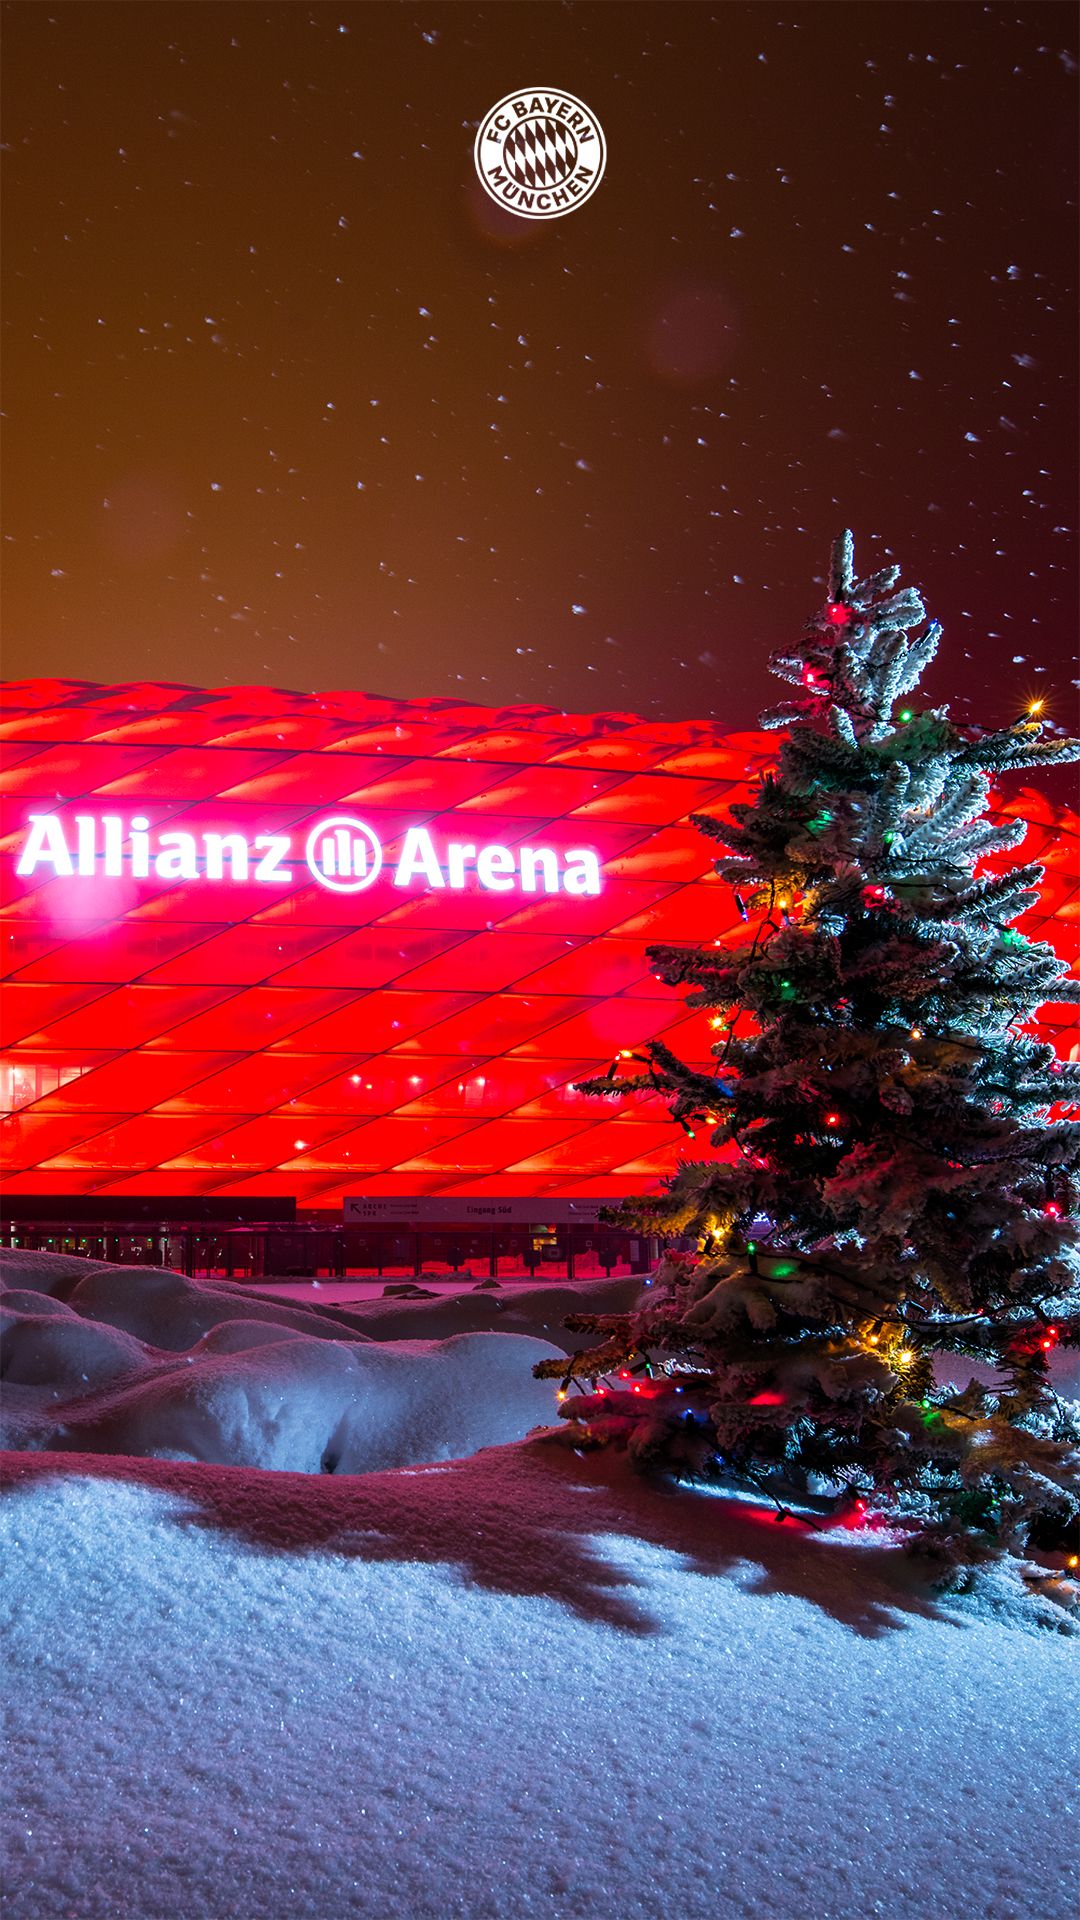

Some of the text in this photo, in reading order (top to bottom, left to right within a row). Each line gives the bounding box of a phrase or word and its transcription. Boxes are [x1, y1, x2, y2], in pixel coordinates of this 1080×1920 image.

[16, 815, 601, 896] Allianz Arena
[466, 1205, 496, 1216] Eingang
